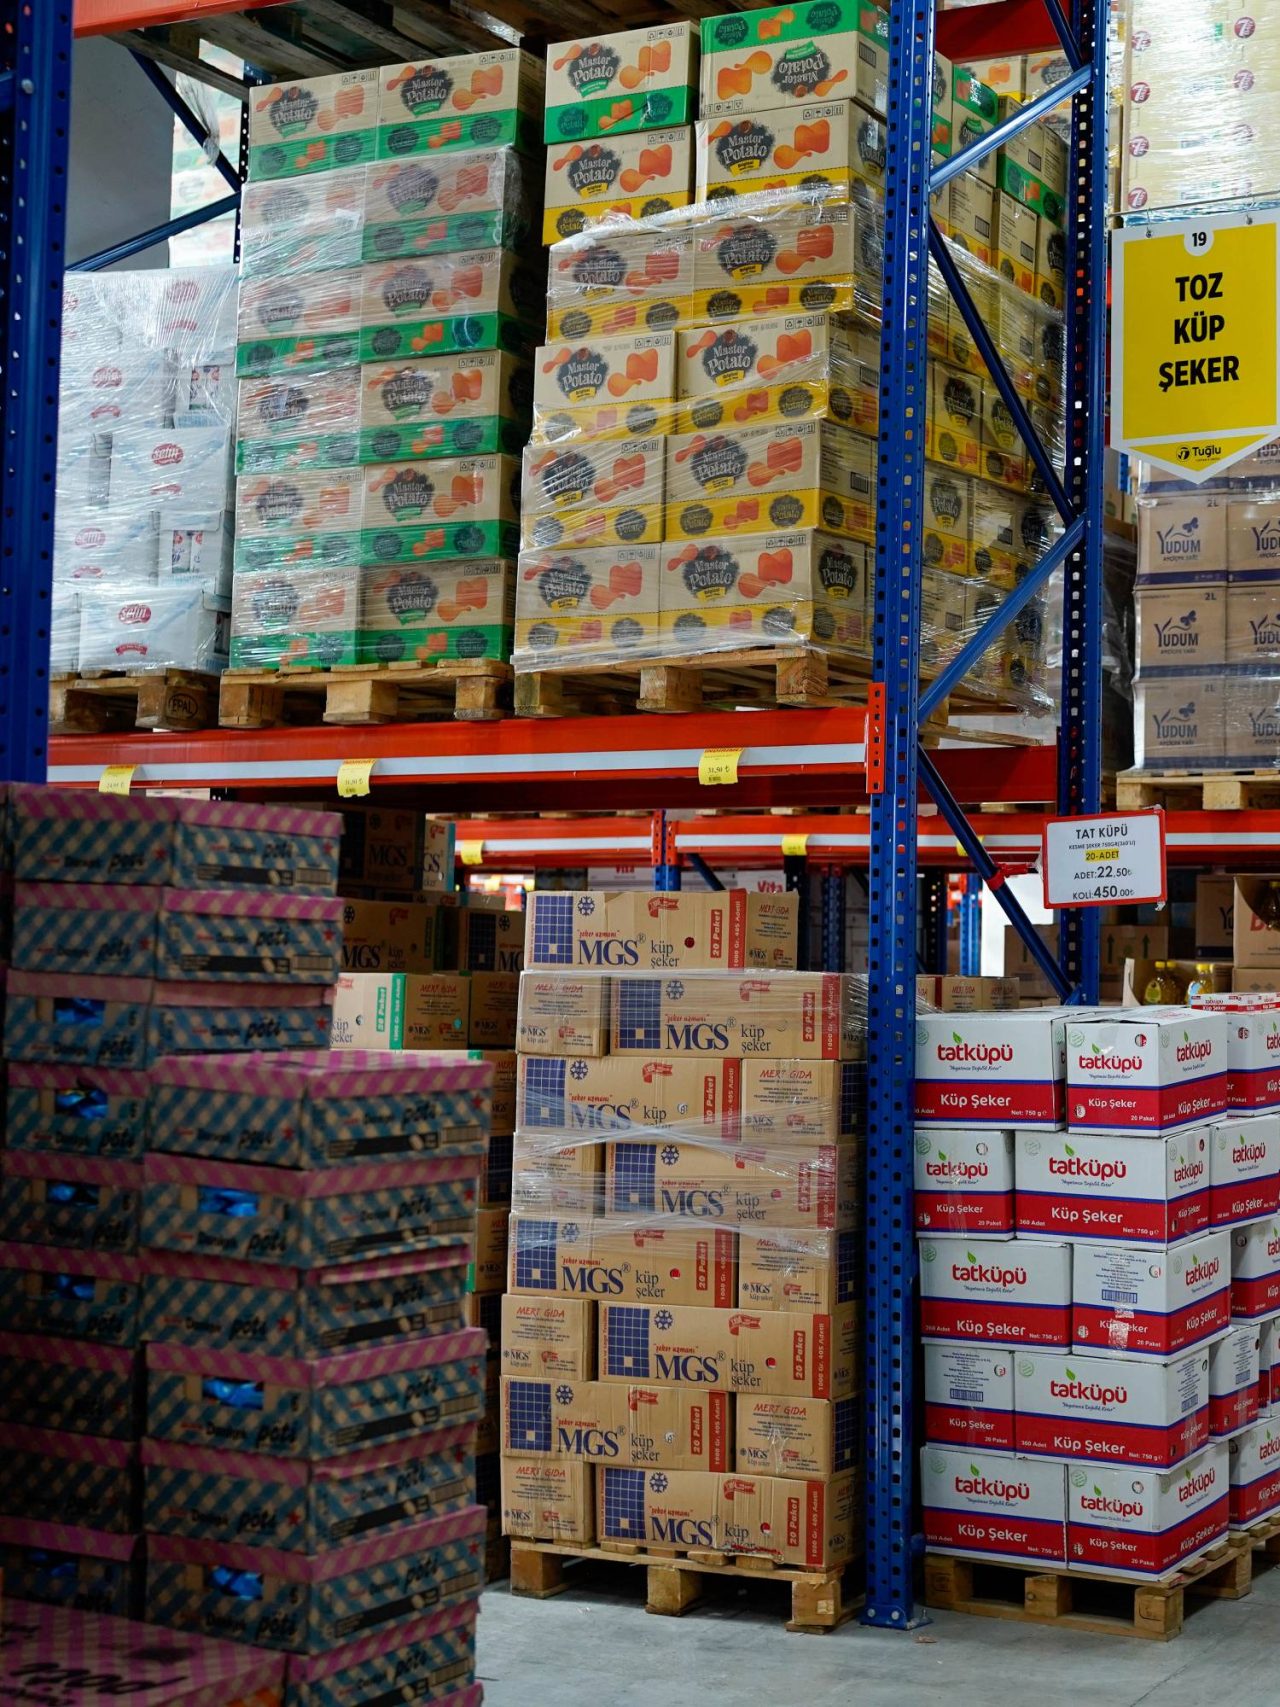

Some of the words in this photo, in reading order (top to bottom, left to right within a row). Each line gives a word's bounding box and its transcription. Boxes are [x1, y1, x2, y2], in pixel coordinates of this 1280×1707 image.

[578, 56, 609, 67] Master
[574, 65, 614, 85] Potato
[728, 134, 764, 147] Master
[723, 143, 767, 163] Potato
[578, 158, 611, 170] Master
[574, 169, 614, 188] Potato
[1192, 232, 1207, 247] 19
[1175, 272, 1223, 302] TOZ
[1174, 311, 1225, 344] KÜP
[714, 345, 748, 356] Master
[567, 361, 600, 374] Master
[707, 354, 751, 373] Potato
[562, 372, 603, 392] Potato
[1158, 355, 1240, 392] ŞEKER
[1193, 444, 1222, 458] Tuğlu
[1207, 499, 1219, 508] 2L
[1157, 525, 1200, 554] YUDUM
[688, 571, 732, 588] Potato
[1205, 593, 1217, 601] 2L
[1154, 617, 1198, 647] YUDUM
[1153, 709, 1197, 738] YUDUM
[1076, 828, 1095, 840] TAT
[1099, 823, 1128, 838] KÜPÜ
[713, 911, 721, 942] Paket
[651, 940, 674, 957] küp
[712, 943, 720, 957] 20
[651, 955, 680, 969] şeker
[741, 1025, 765, 1042] küp
[741, 1039, 770, 1053] şeker
[937, 1043, 1013, 1064] tatküpü
[1177, 1040, 1212, 1063] tatküpü
[1078, 1055, 1143, 1073] tatküpü
[759, 1069, 786, 1079] MERT
[789, 1069, 812, 1079] GIDA
[940, 1094, 967, 1107] Küp
[971, 1094, 1012, 1108] Şeker
[1088, 1098, 1107, 1109] Küp
[1109, 1098, 1136, 1109] Şeker
[643, 1106, 667, 1123] küp
[1049, 1157, 1127, 1181] tatküpü
[735, 1192, 760, 1209] küp
[1051, 1207, 1079, 1222] Küp
[1082, 1210, 1123, 1224] Şeker
[635, 1269, 658, 1287] küp
[952, 1263, 1027, 1287] tatküpü
[636, 1284, 665, 1298] şeker
[516, 1306, 540, 1315] MERT
[544, 1308, 565, 1318] GIDA
[956, 1320, 983, 1334] Küp
[986, 1321, 1025, 1336] Şeker
[795, 1332, 804, 1363] Paket
[731, 1359, 755, 1374] küp
[795, 1364, 803, 1378] 20
[1050, 1380, 1127, 1405] tatküpü
[753, 1403, 780, 1413] MERT
[784, 1405, 807, 1416] GIDA
[631, 1432, 655, 1450] küp
[1054, 1437, 1081, 1451] Küp
[1085, 1440, 1125, 1455] Şeker
[631, 1448, 660, 1462] şeker
[955, 1476, 1030, 1500] tatküpü
[1081, 1494, 1143, 1517] tatküpü
[724, 1523, 749, 1541] küp
